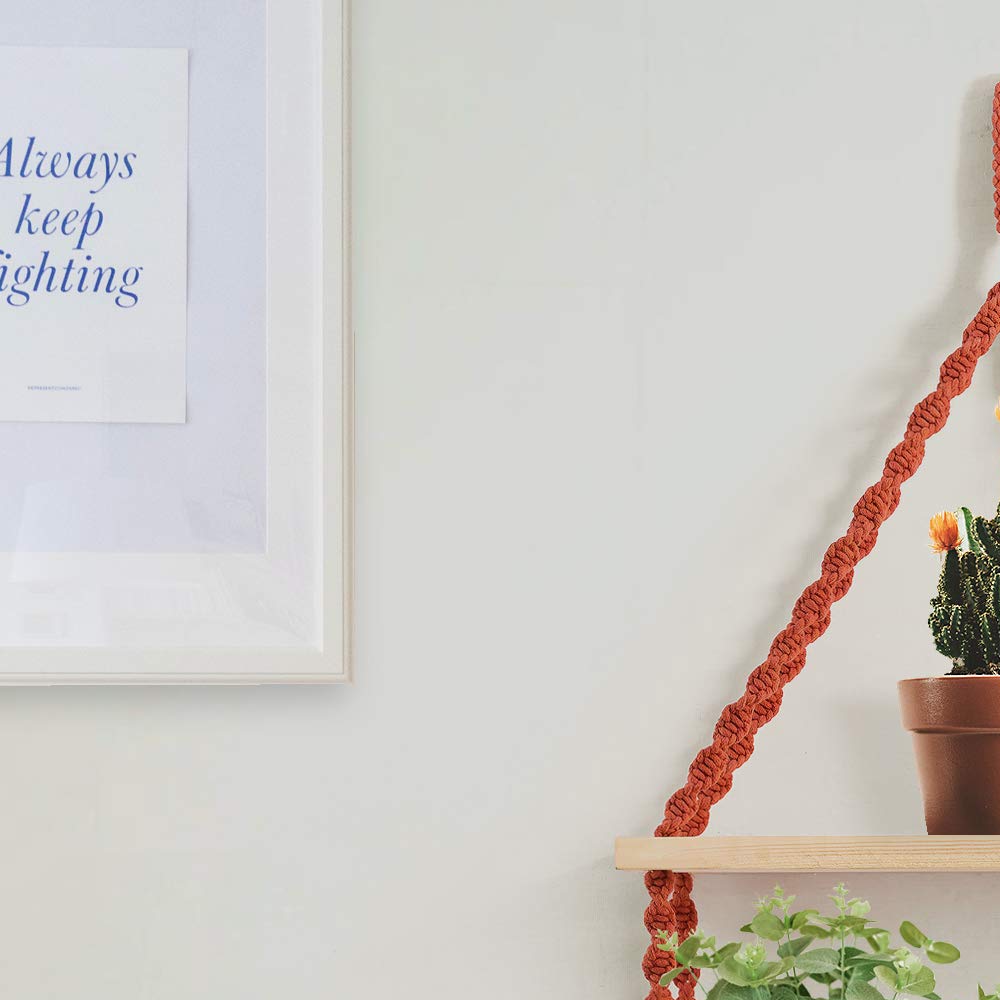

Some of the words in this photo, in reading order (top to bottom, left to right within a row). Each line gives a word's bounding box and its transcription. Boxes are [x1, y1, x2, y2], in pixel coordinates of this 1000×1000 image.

[0, 136, 137, 194] Always
[14, 193, 104, 250] keep
[0, 250, 143, 308] ighting
